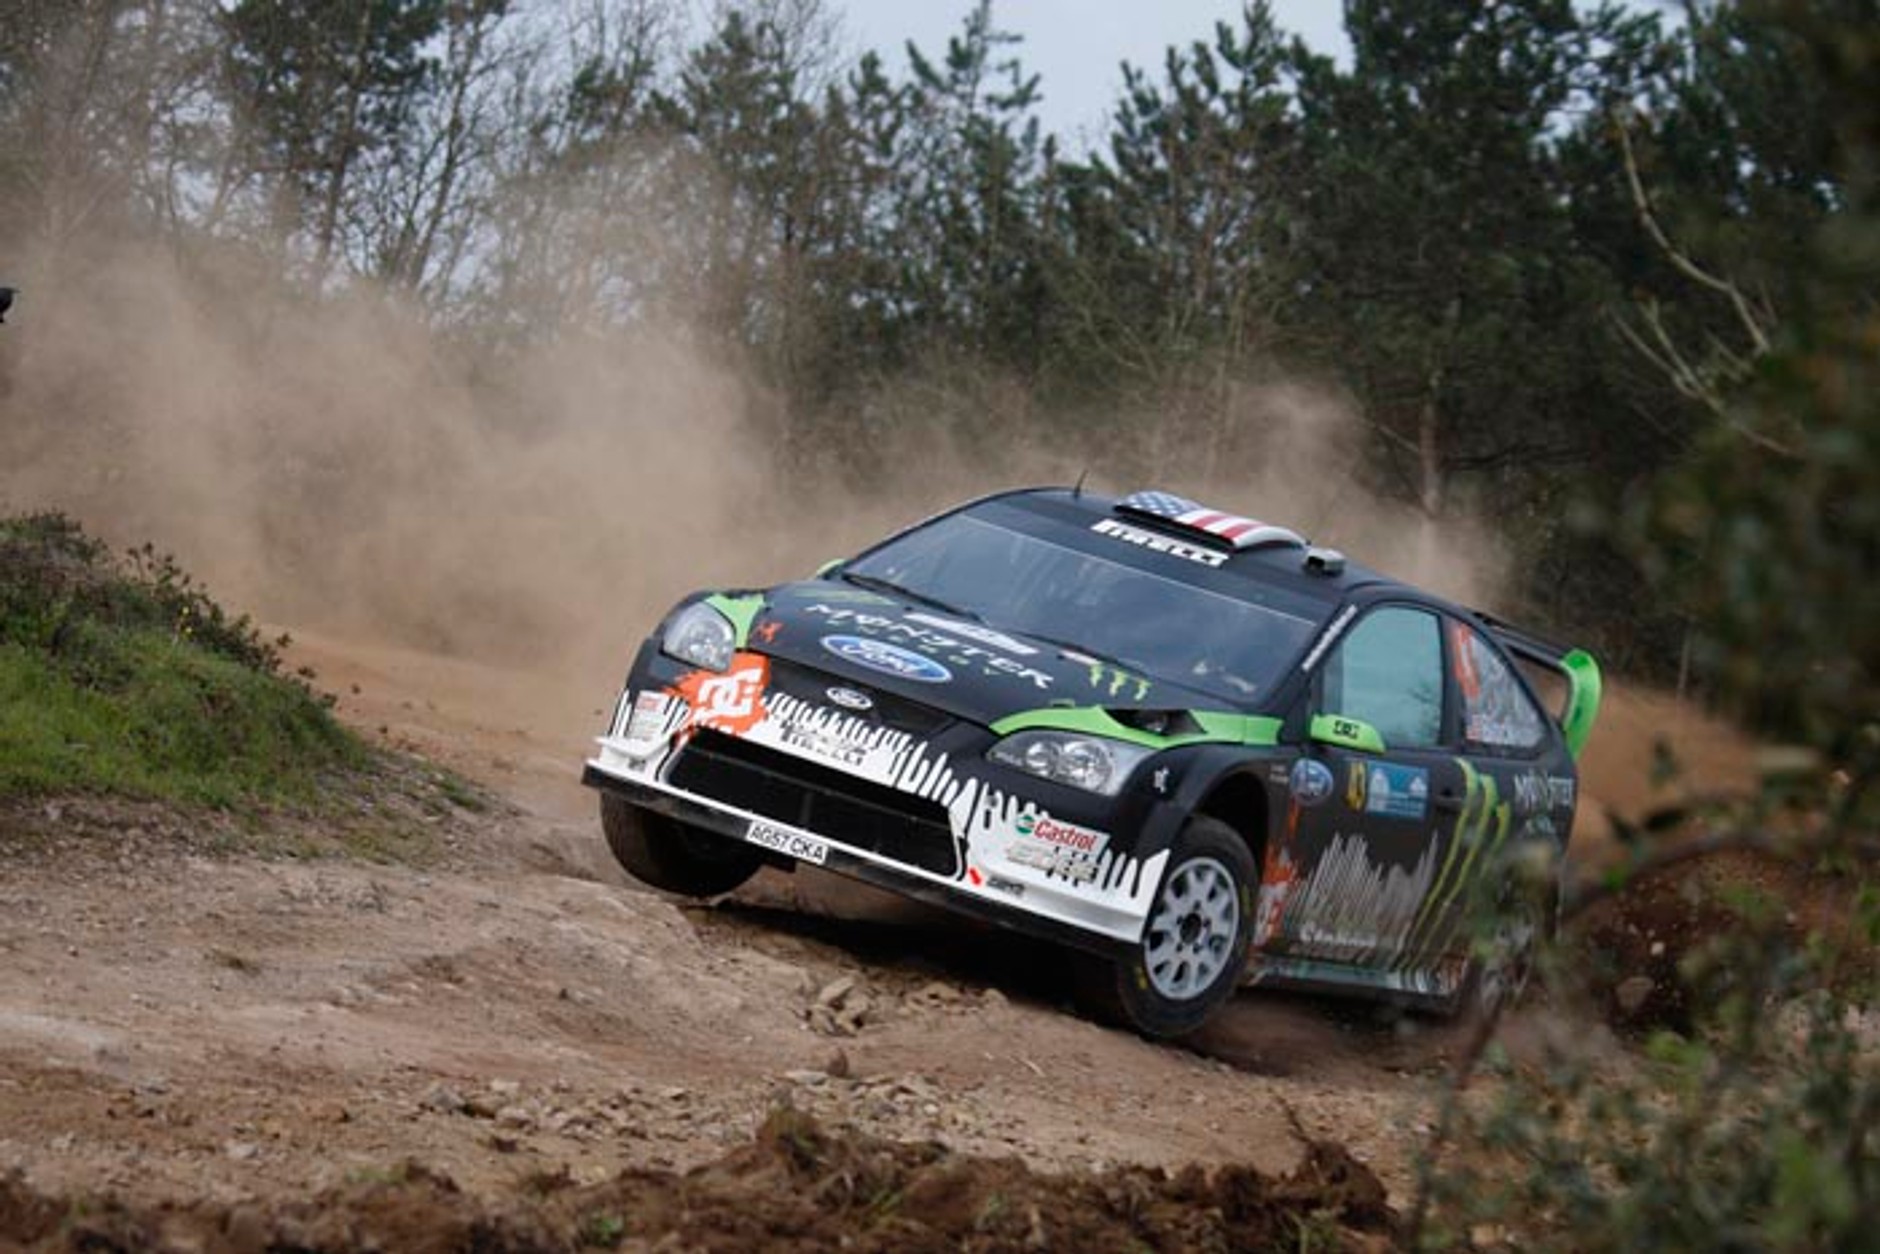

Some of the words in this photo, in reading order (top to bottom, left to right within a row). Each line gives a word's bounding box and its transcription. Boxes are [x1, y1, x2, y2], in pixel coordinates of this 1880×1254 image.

[1091, 518, 1229, 568] PIRELLI
[804, 603, 1054, 689] MONSTER
[693, 667, 764, 718] DC
[789, 836, 825, 861] CKA
[1033, 818, 1097, 853] Castrol
